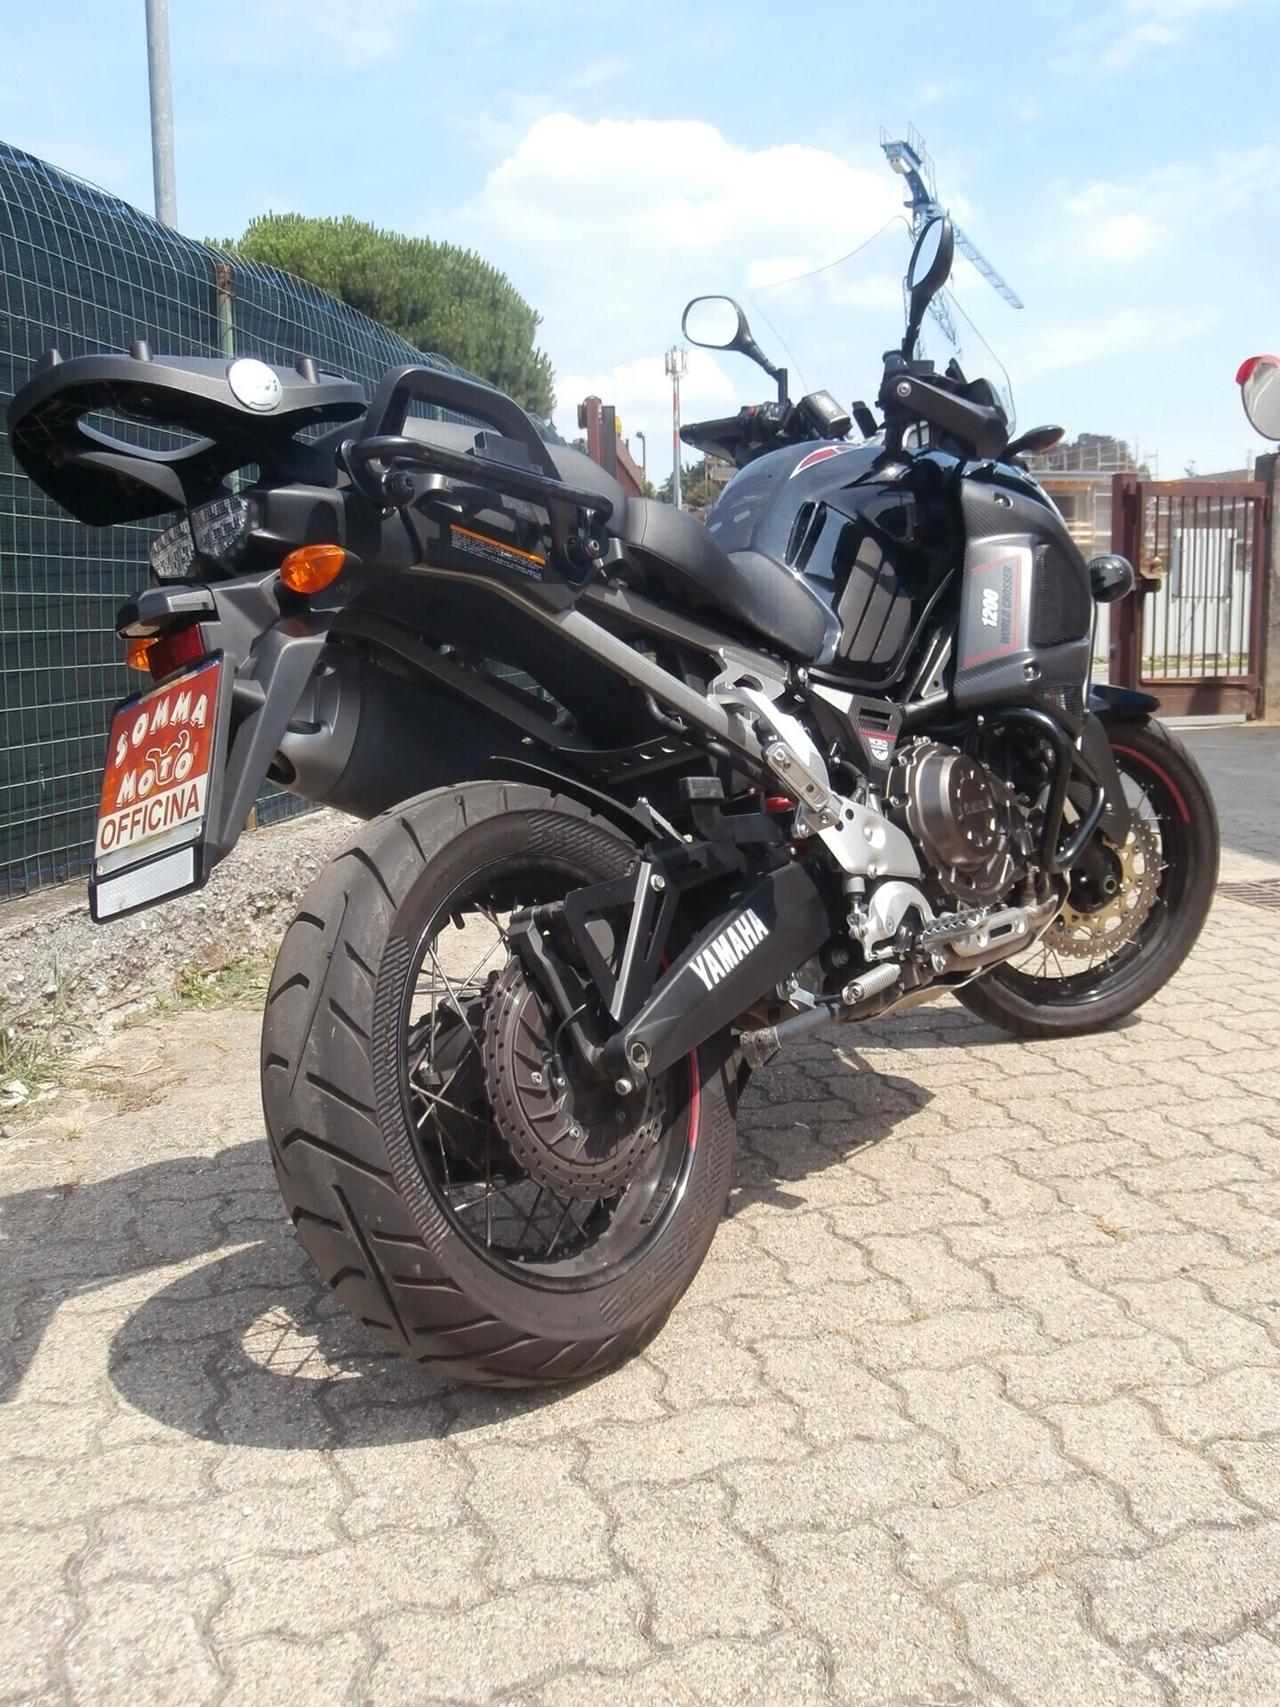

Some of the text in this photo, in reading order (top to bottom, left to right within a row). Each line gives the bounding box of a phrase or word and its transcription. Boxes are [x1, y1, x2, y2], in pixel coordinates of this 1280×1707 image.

[981, 588, 999, 627] 1200
[1000, 610, 1011, 644] WORLD
[115, 690, 208, 768] SOMMA
[116, 750, 194, 807] MOTO
[100, 783, 200, 850] OFFICINA
[688, 908, 770, 991] YAMAHA
